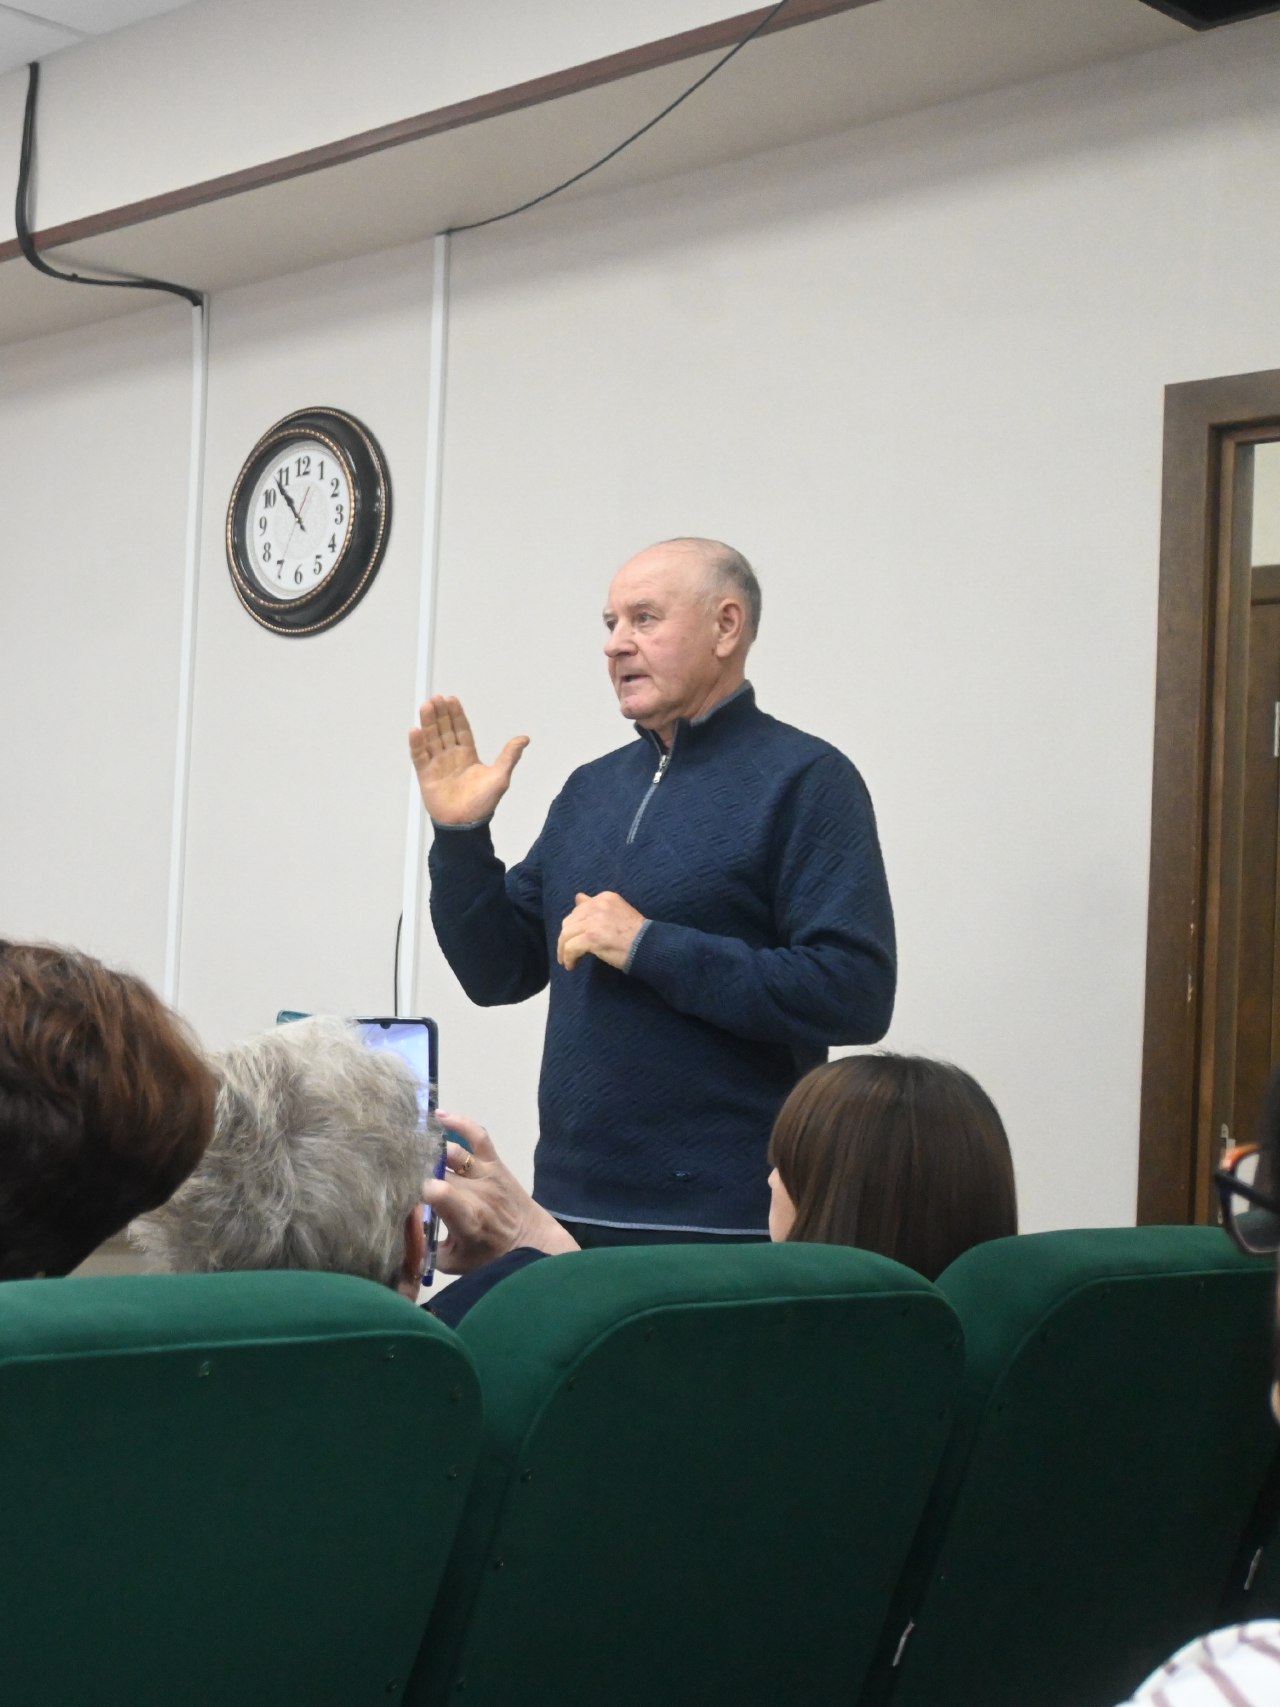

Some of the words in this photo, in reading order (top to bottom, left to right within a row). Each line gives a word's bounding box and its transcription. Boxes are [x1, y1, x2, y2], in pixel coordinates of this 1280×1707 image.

[277, 467, 290, 486] 11
[295, 456, 311, 477] 12
[317, 460, 325, 480] 1
[330, 478, 340, 498] 2
[263, 488, 276, 509] 10
[334, 504, 344, 525] 3
[259, 516, 267, 536] 9
[262, 542, 271, 562] 8
[328, 533, 337, 553] 4
[277, 559, 285, 580] 7
[294, 564, 303, 585] 6
[313, 555, 322, 575] 5
